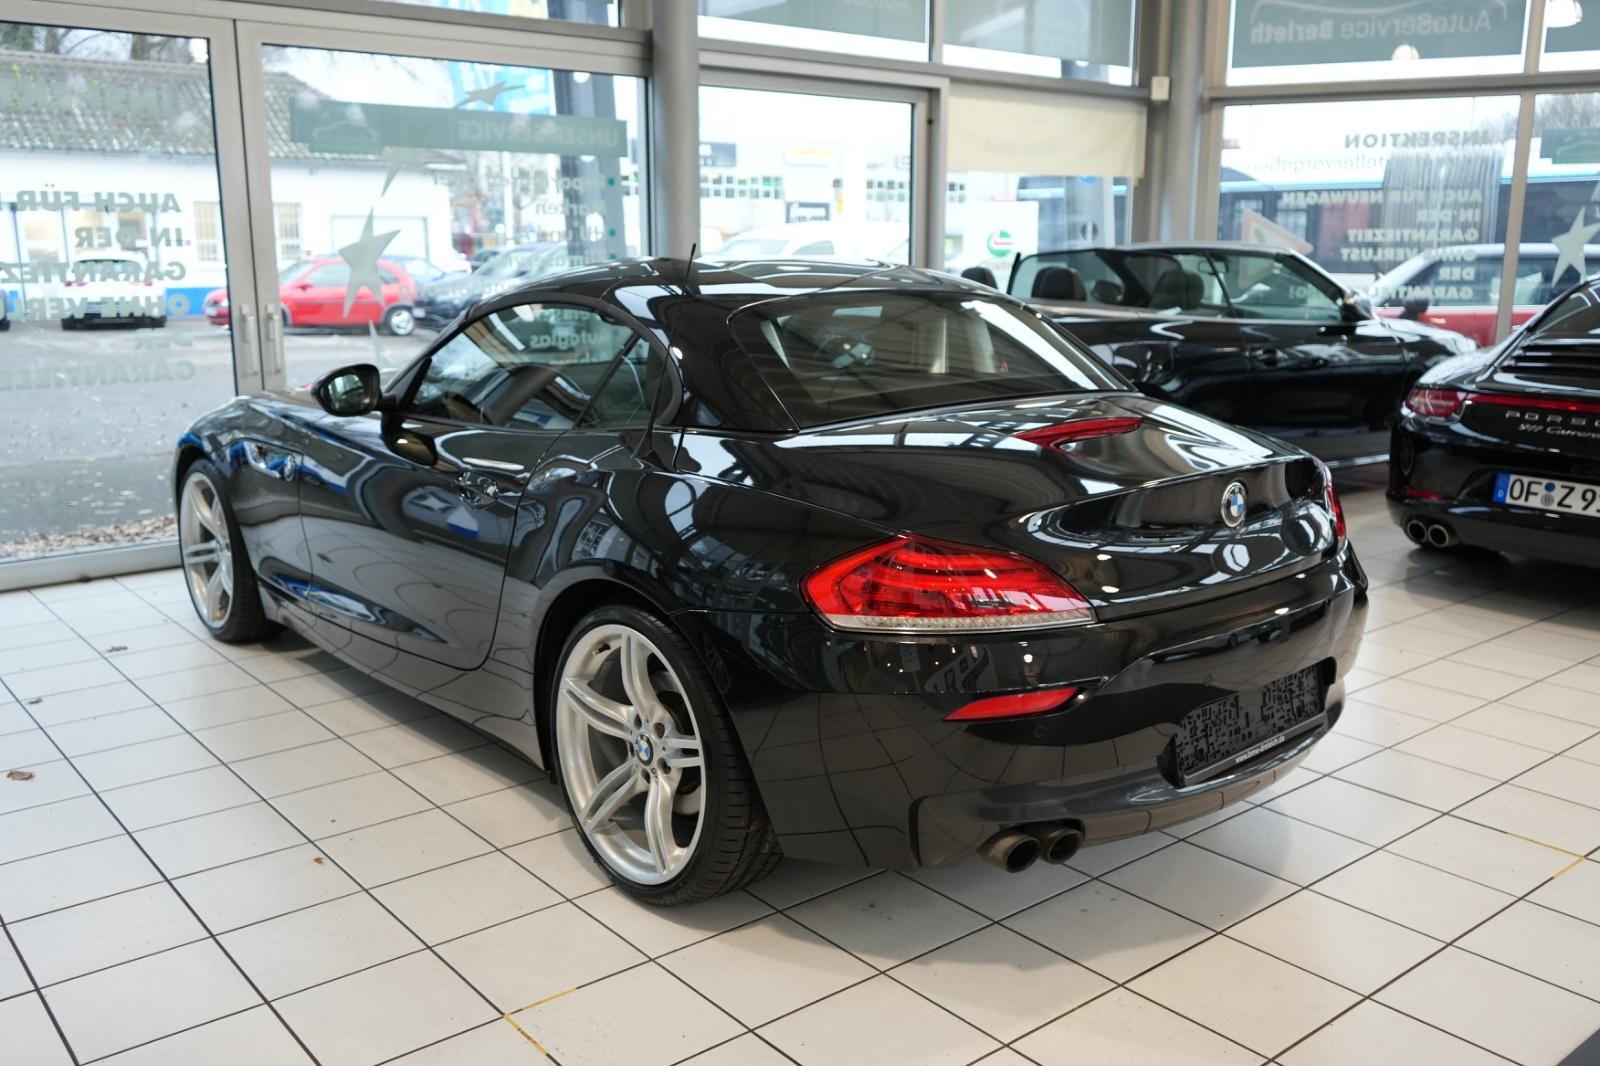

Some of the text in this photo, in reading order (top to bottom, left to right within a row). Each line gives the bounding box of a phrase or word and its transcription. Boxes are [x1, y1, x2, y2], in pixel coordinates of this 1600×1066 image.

[1509, 477, 1600, 513] OF Z 9
